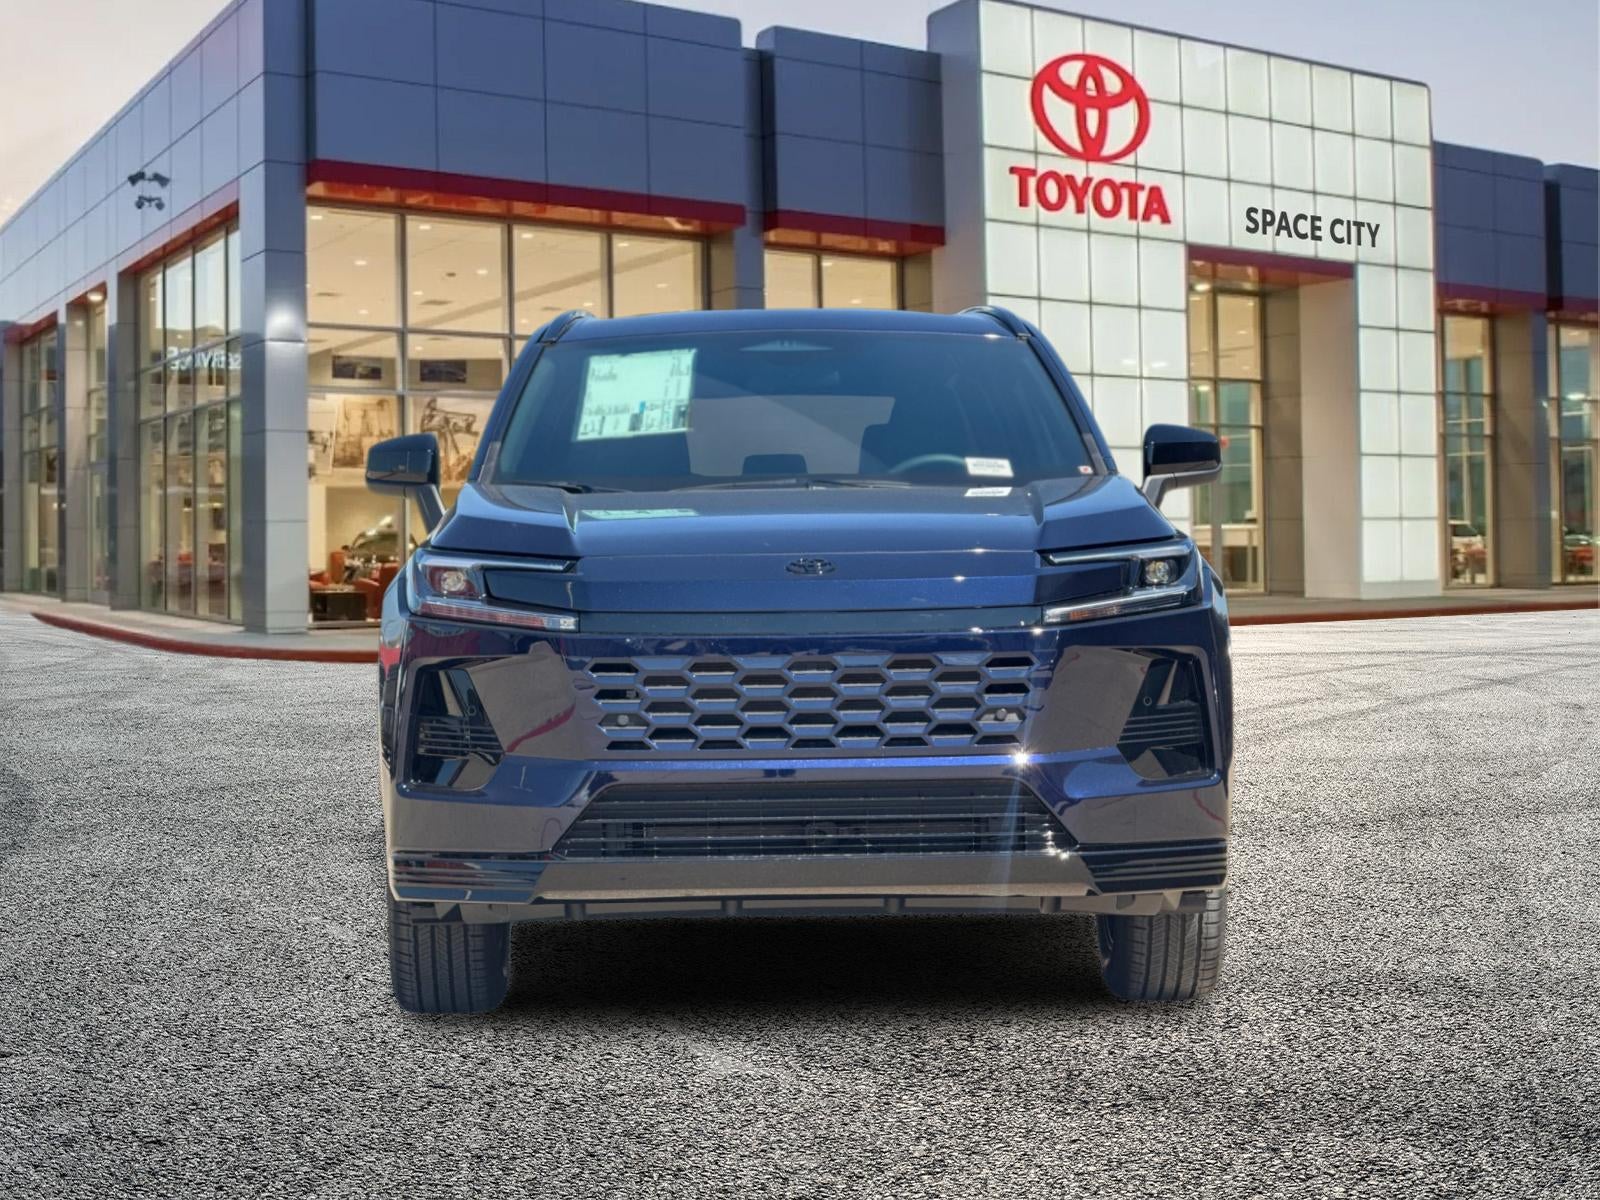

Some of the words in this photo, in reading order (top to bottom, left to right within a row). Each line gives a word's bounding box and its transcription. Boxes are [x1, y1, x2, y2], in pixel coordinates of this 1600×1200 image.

[1010, 166, 1171, 224] TOYOTA
[1245, 207, 1322, 242] SPACE
[1329, 218, 1381, 248] CITY
